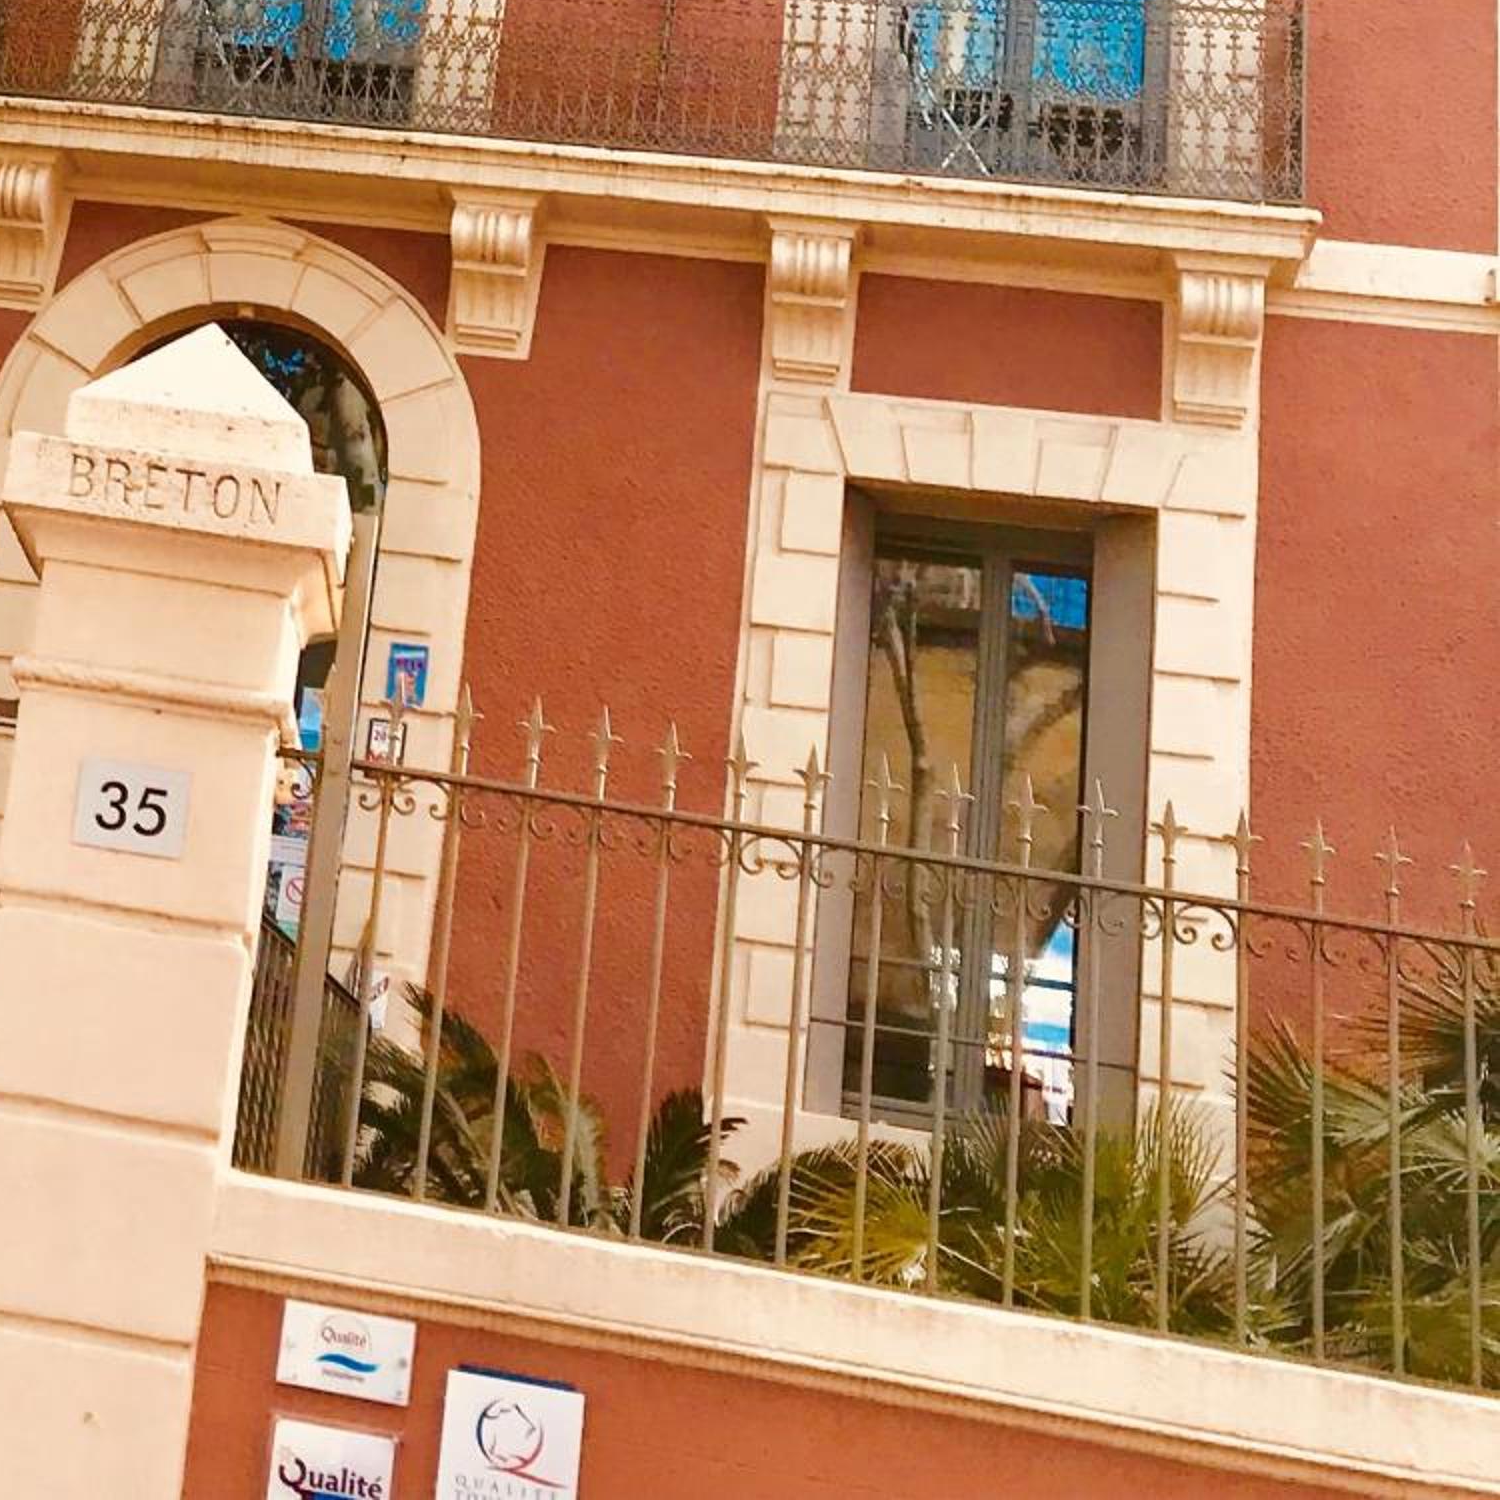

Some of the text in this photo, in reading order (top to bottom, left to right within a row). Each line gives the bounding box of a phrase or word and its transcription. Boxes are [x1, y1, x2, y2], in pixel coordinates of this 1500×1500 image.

[68, 453, 283, 526] BRETON
[94, 780, 168, 837] 35
[278, 1457, 383, 1500] Qualité
